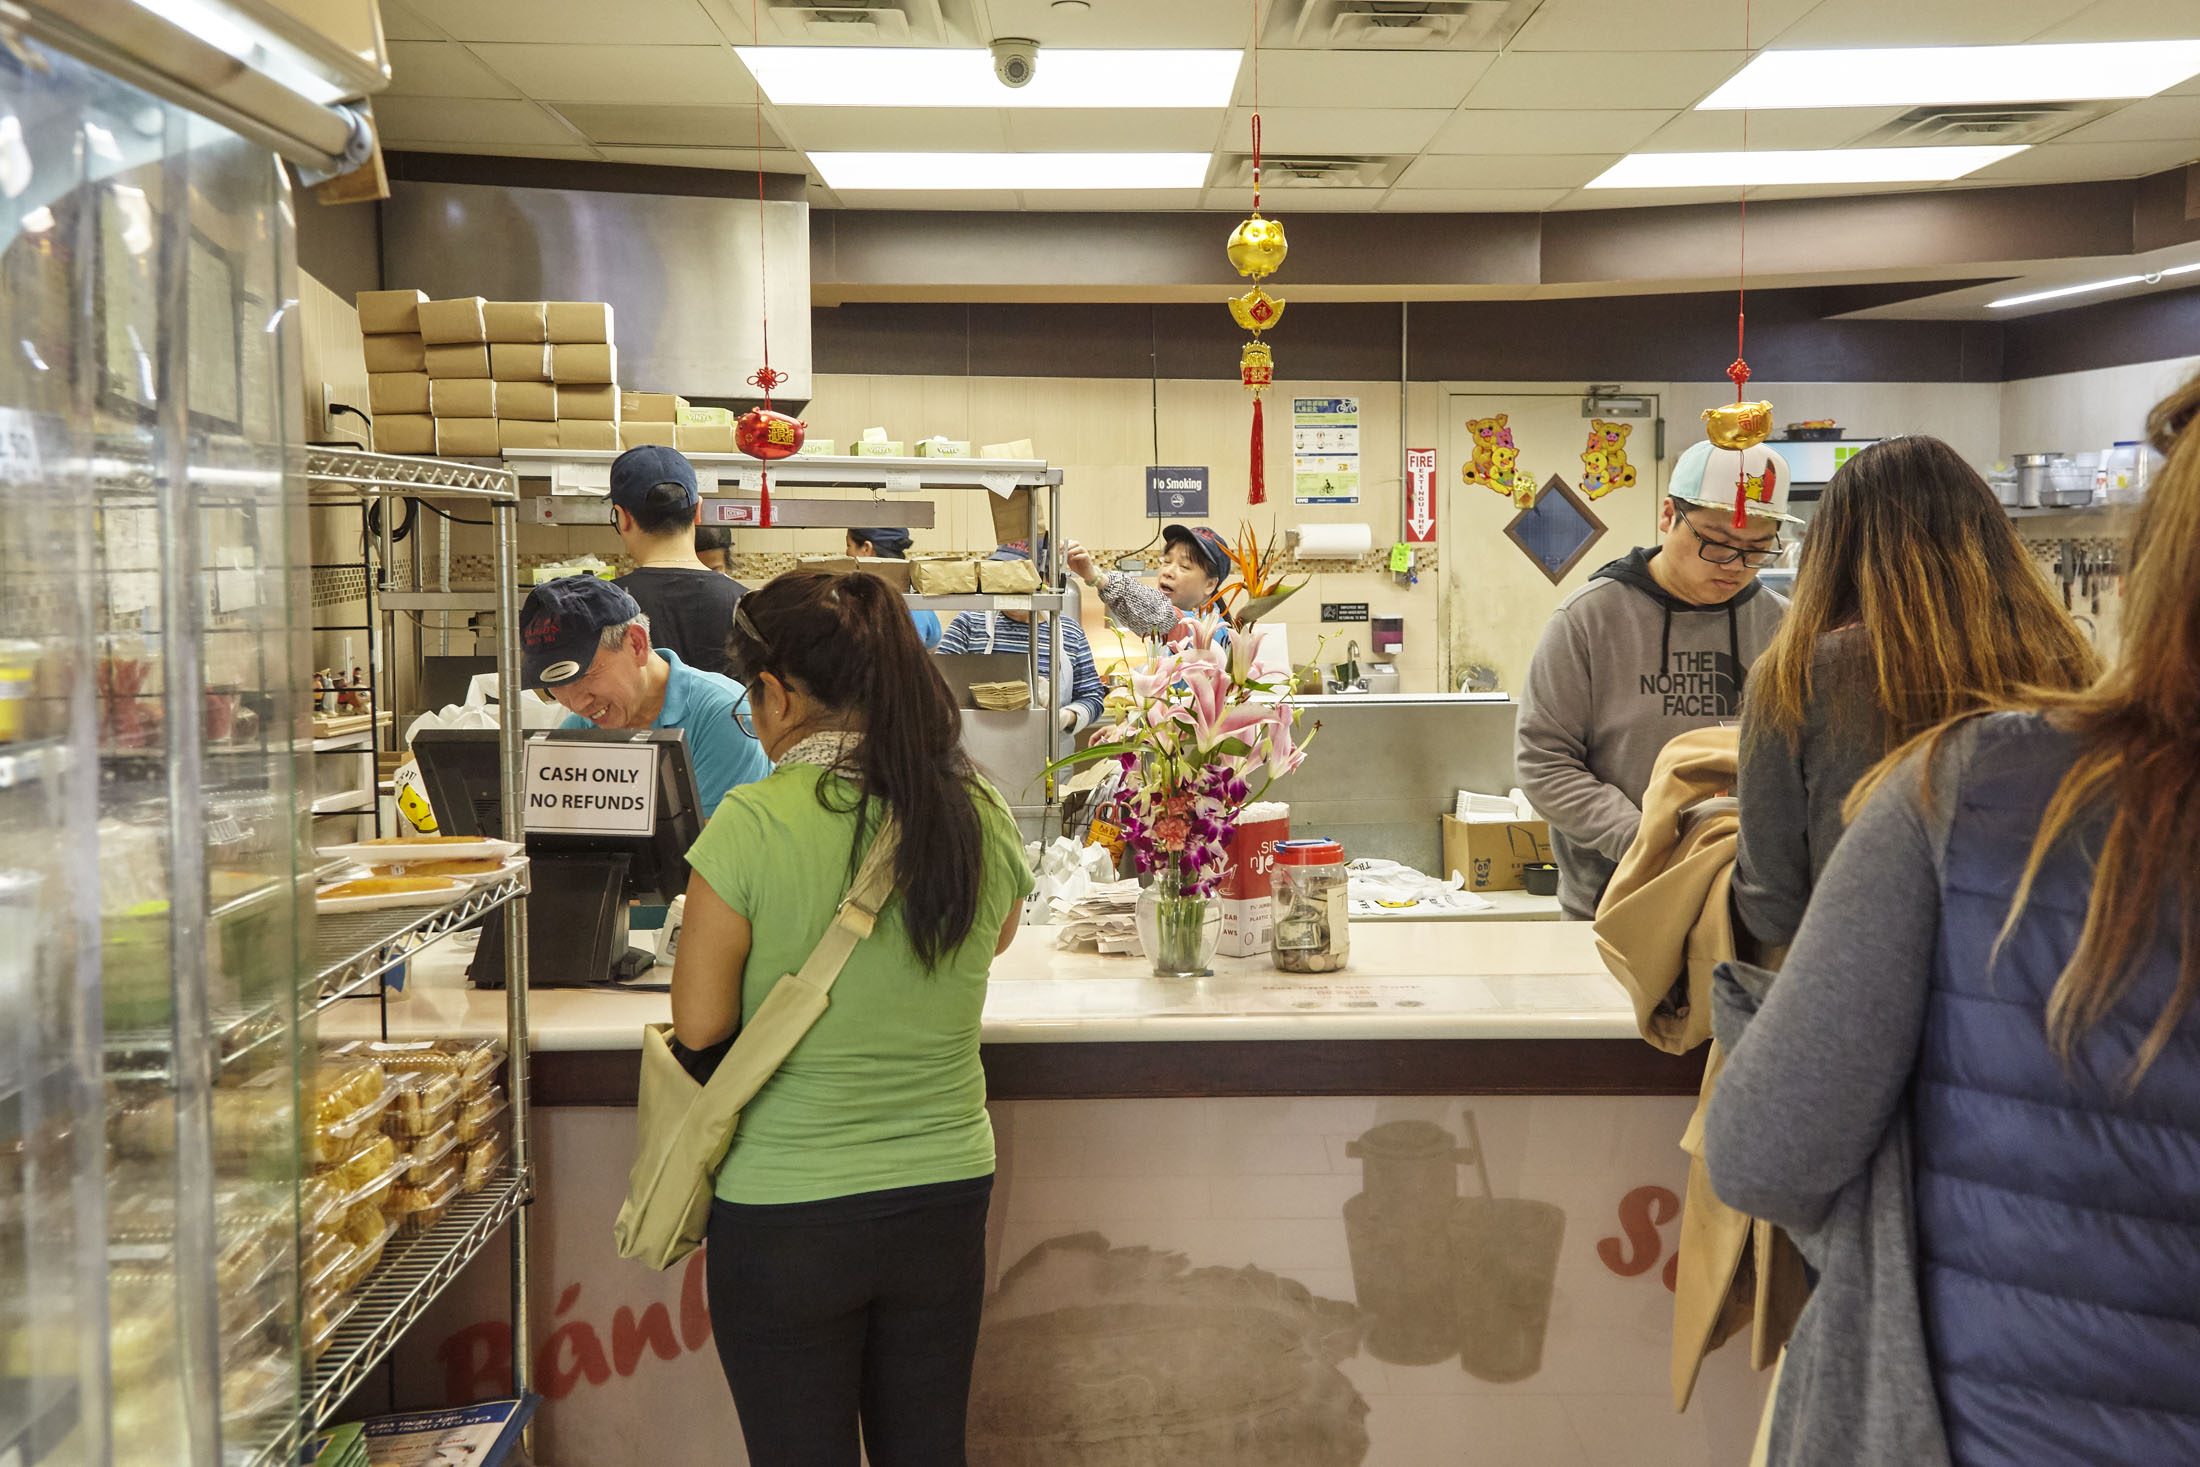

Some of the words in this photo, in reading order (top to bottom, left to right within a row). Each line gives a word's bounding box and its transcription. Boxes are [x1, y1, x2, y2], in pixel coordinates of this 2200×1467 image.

[1410, 455, 1433, 468] FIRE
[1166, 477, 1202, 491] Smoking
[1672, 652, 1713, 672] THE
[1640, 673, 1714, 694] NORTH
[1663, 695, 1714, 716] FACE
[539, 767, 587, 782] CASH
[592, 768, 639, 783] ONLY
[530, 793, 557, 808] NO
[562, 794, 645, 811] REFUNDS
[1224, 913, 1238, 921] EAR
[1223, 928, 1238, 936] AWS
[1597, 1186, 1679, 1293] S
